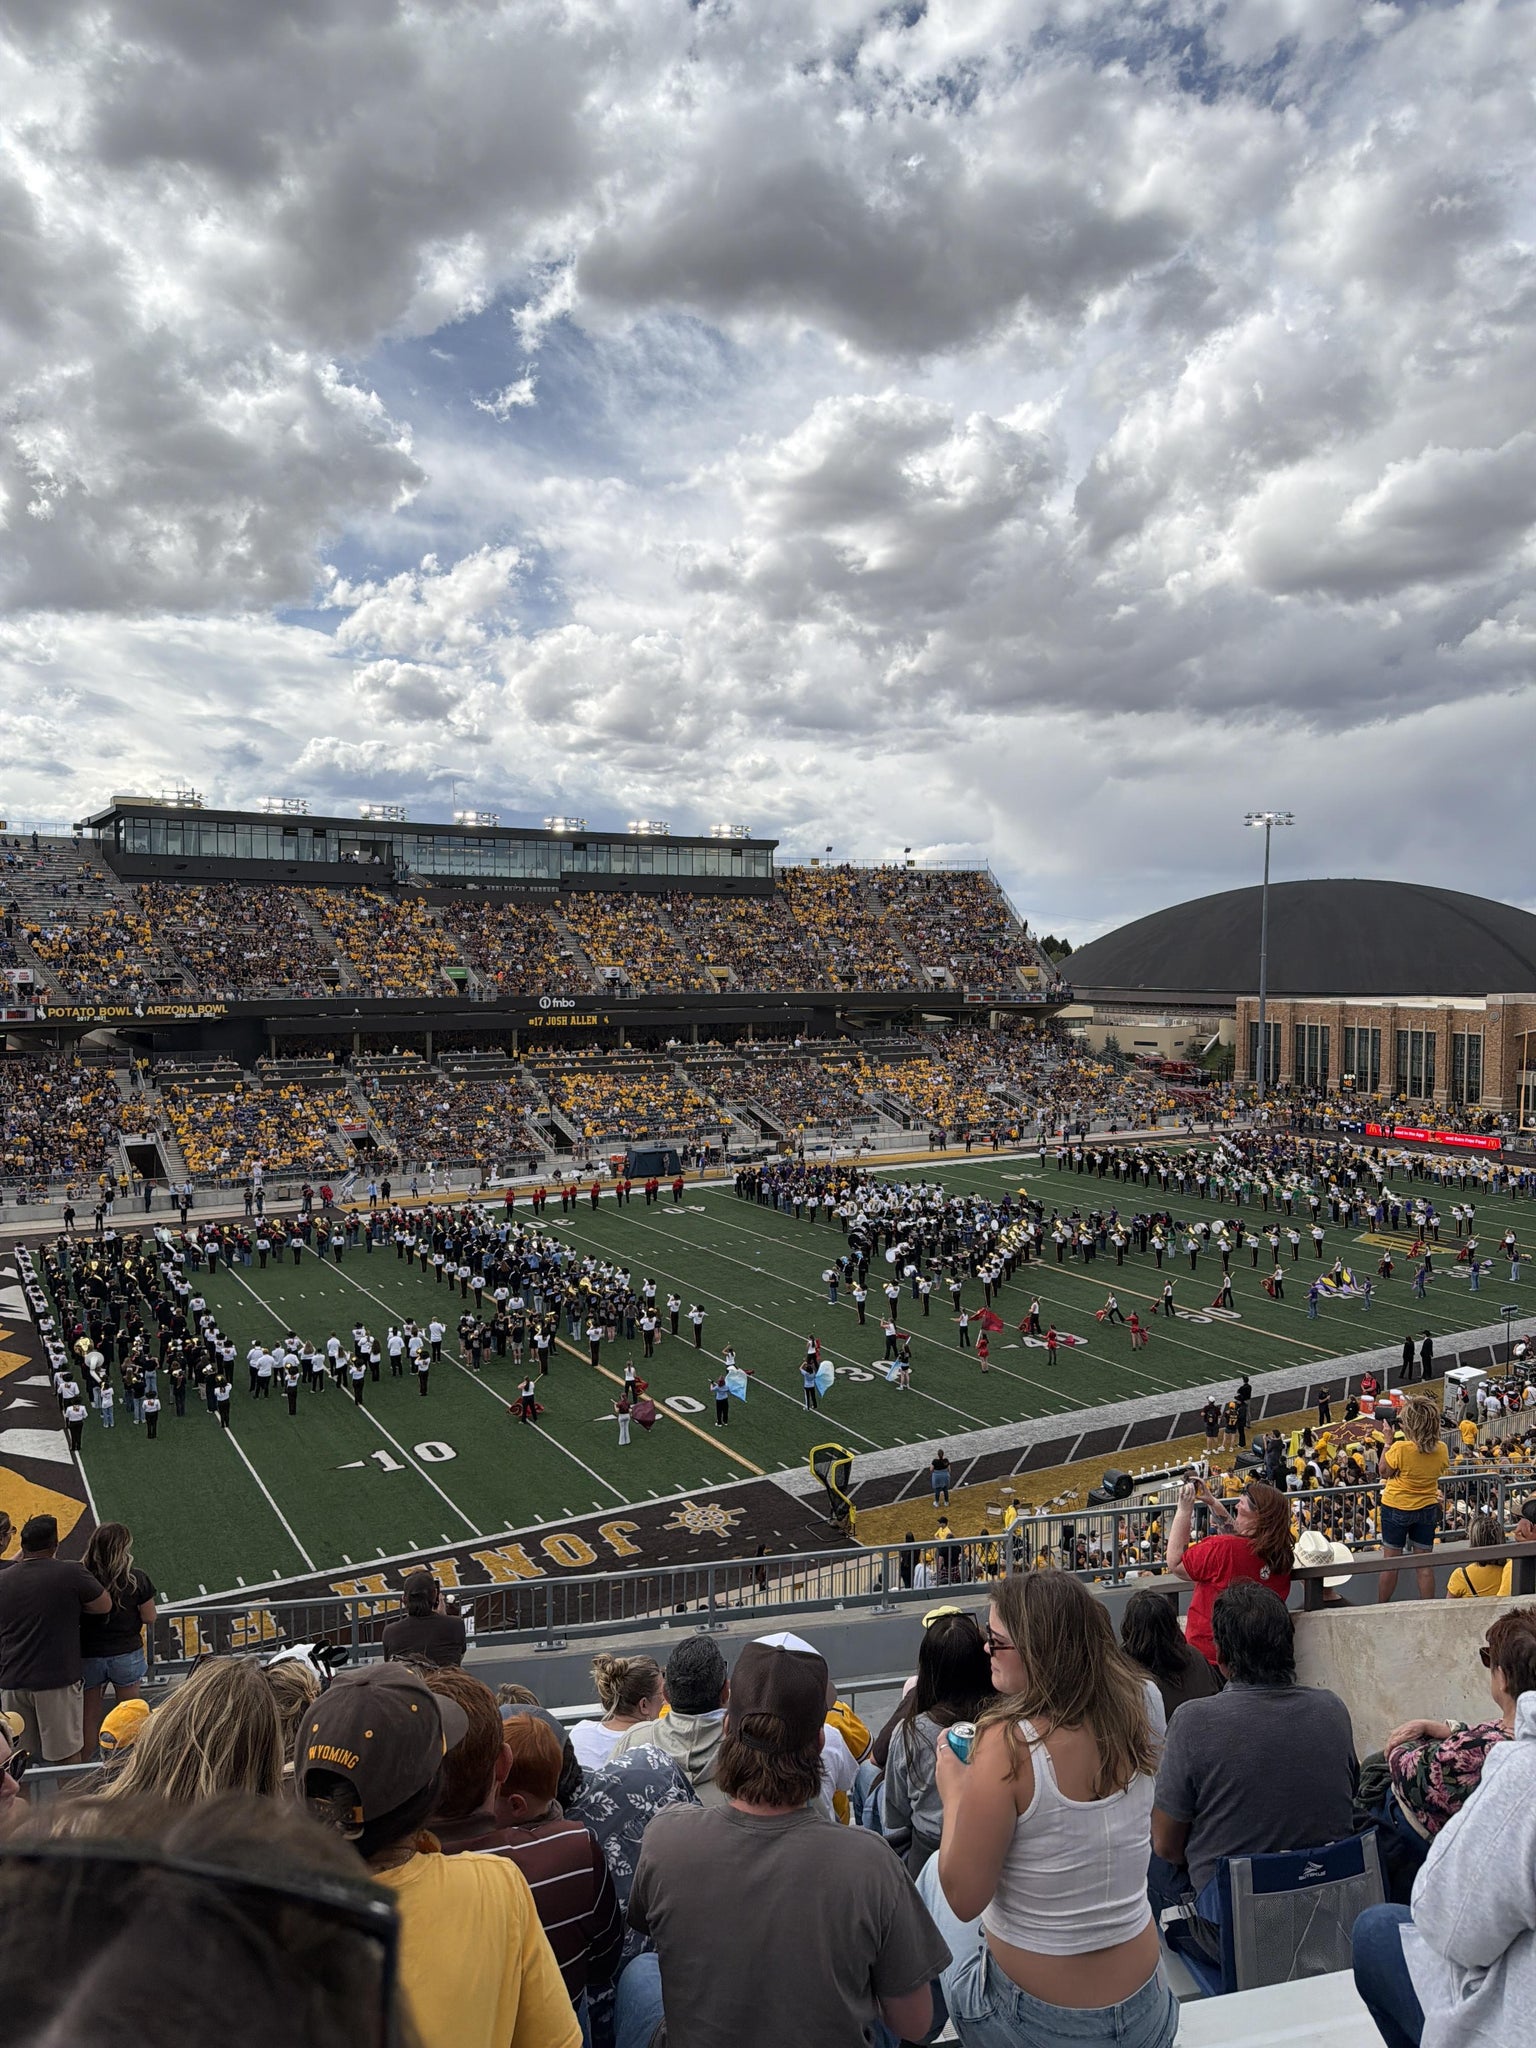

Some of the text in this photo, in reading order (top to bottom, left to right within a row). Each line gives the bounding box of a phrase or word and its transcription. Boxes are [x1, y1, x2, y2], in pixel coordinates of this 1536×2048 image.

[552, 998, 576, 1008] fnbo
[47, 1006, 134, 1018] POTATO BOWL
[146, 1004, 229, 1015] ARIZONA BOWL
[545, 1016, 568, 1026] JOSH
[570, 1015, 598, 1025] ALLEN
[524, 1218, 576, 1229] 30
[1174, 1306, 1242, 1324] 50
[370, 1441, 458, 1472] 10
[308, 1744, 360, 1769] WYOMING
